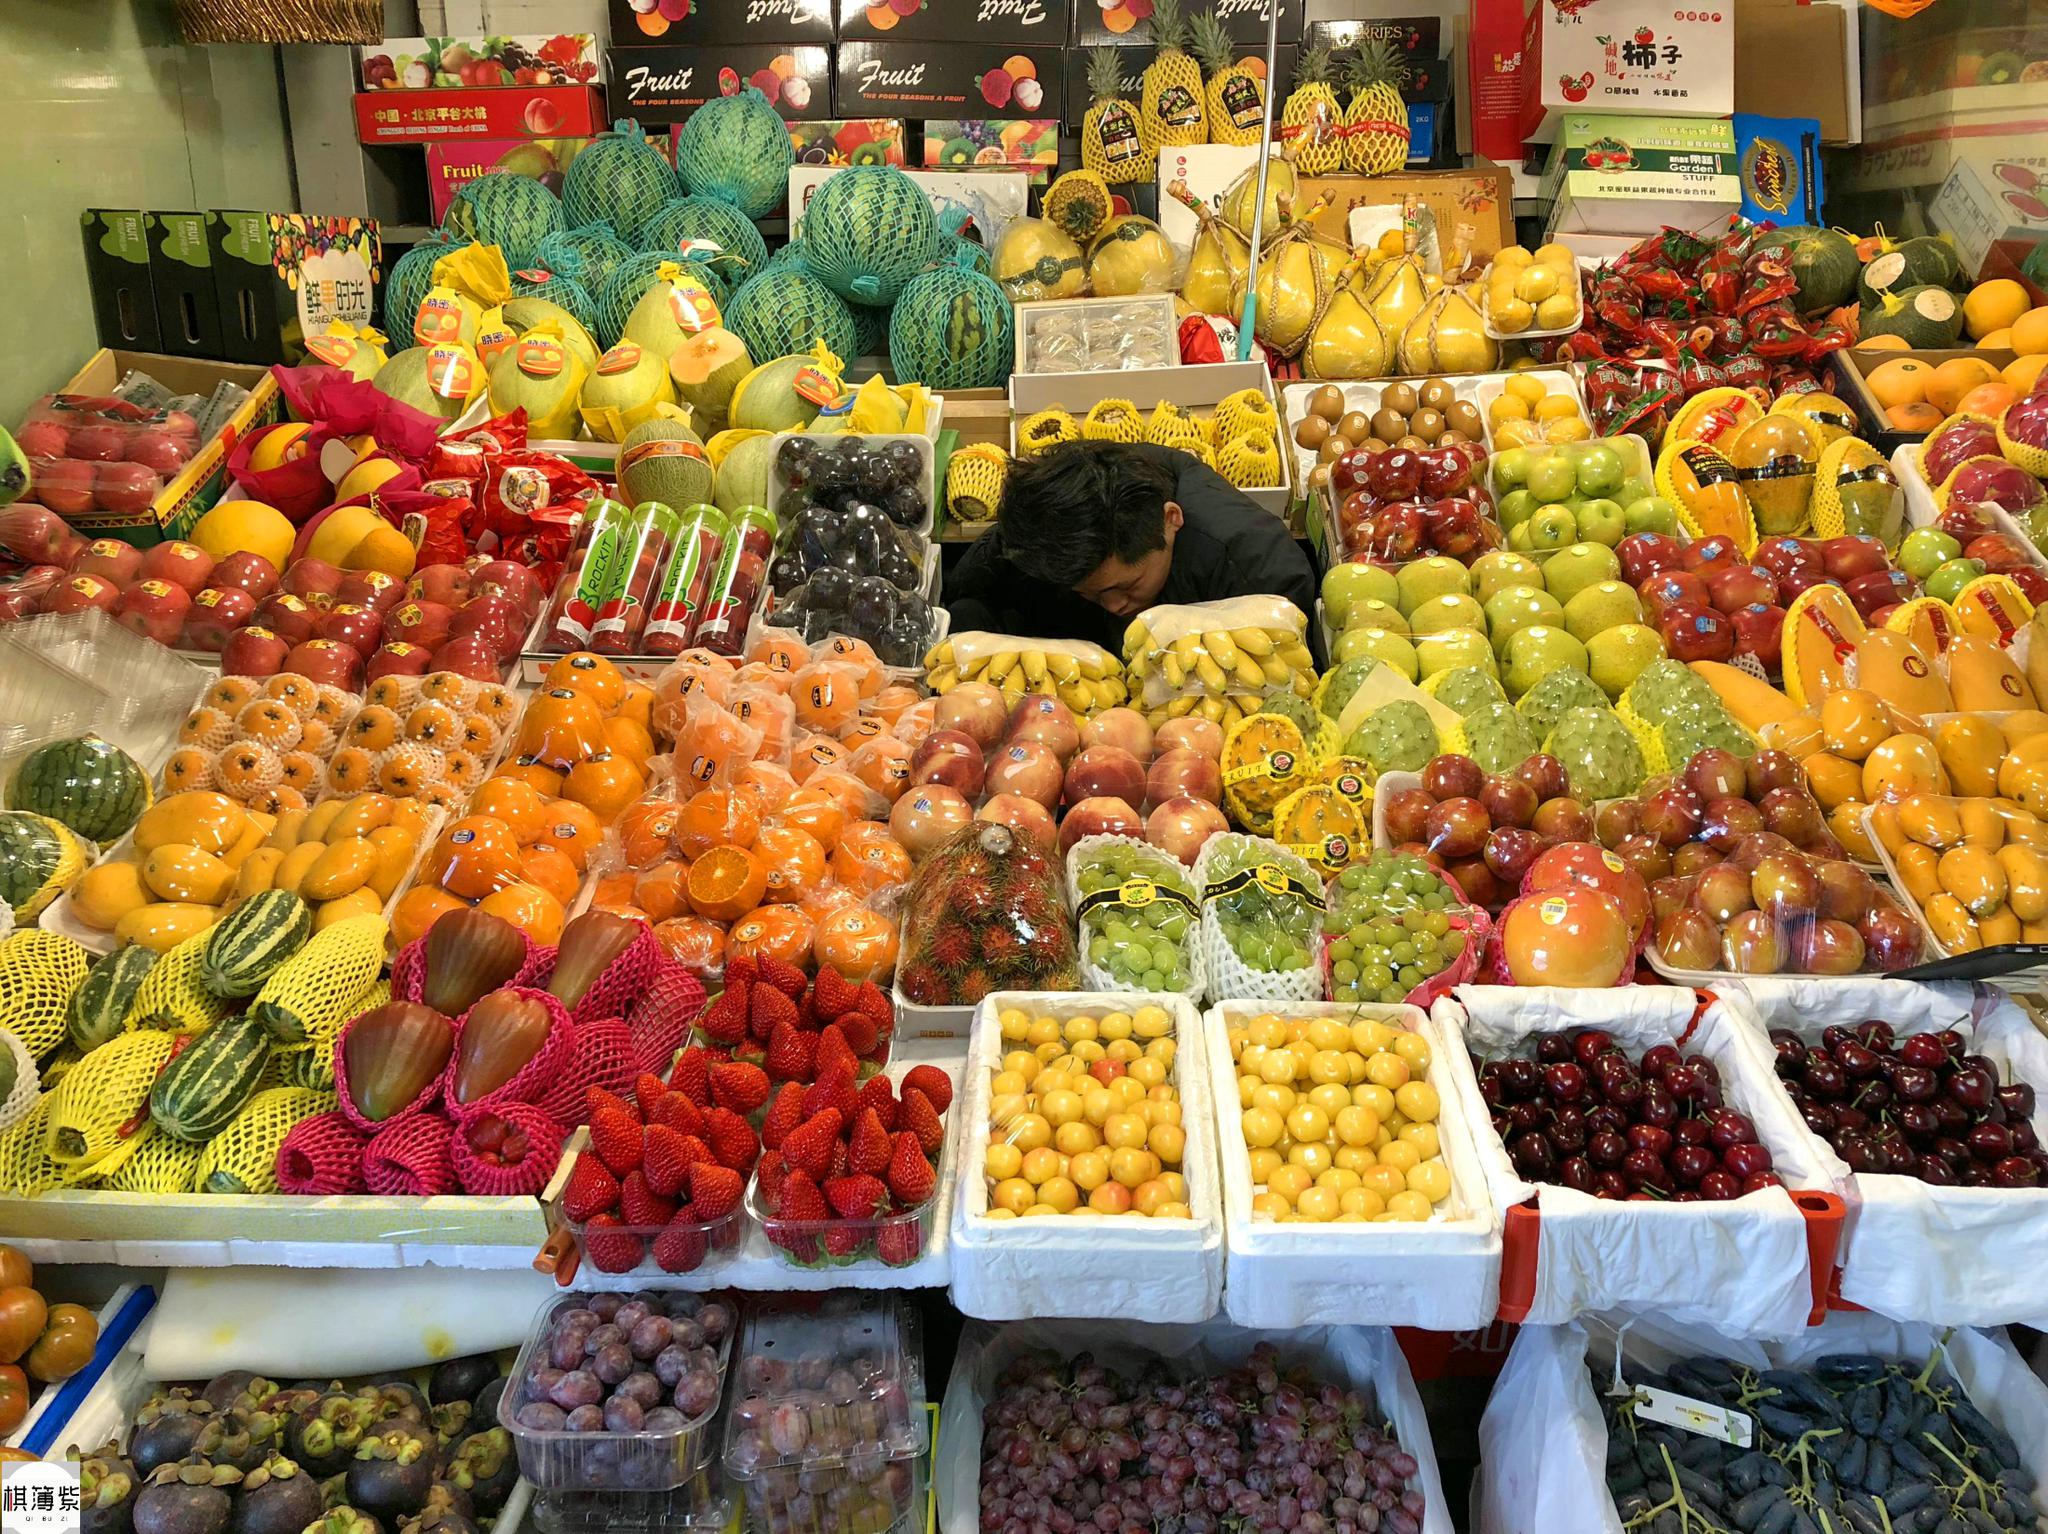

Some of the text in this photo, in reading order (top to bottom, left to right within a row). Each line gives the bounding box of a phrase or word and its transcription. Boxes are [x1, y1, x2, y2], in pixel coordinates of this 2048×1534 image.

[1622, 40, 1682, 69] 柿子
[626, 66, 693, 100] Fruit
[857, 60, 926, 93] Fruit
[443, 164, 484, 178] Fruit
[1669, 163, 1714, 173] Garden
[1682, 174, 1715, 182] STUFF
[125, 217, 139, 242] FRUIT
[185, 221, 200, 246] FRUIT
[247, 218, 261, 243] FRUIT
[588, 538, 612, 592] ROCKIT
[1222, 765, 1262, 782] FRUIT
